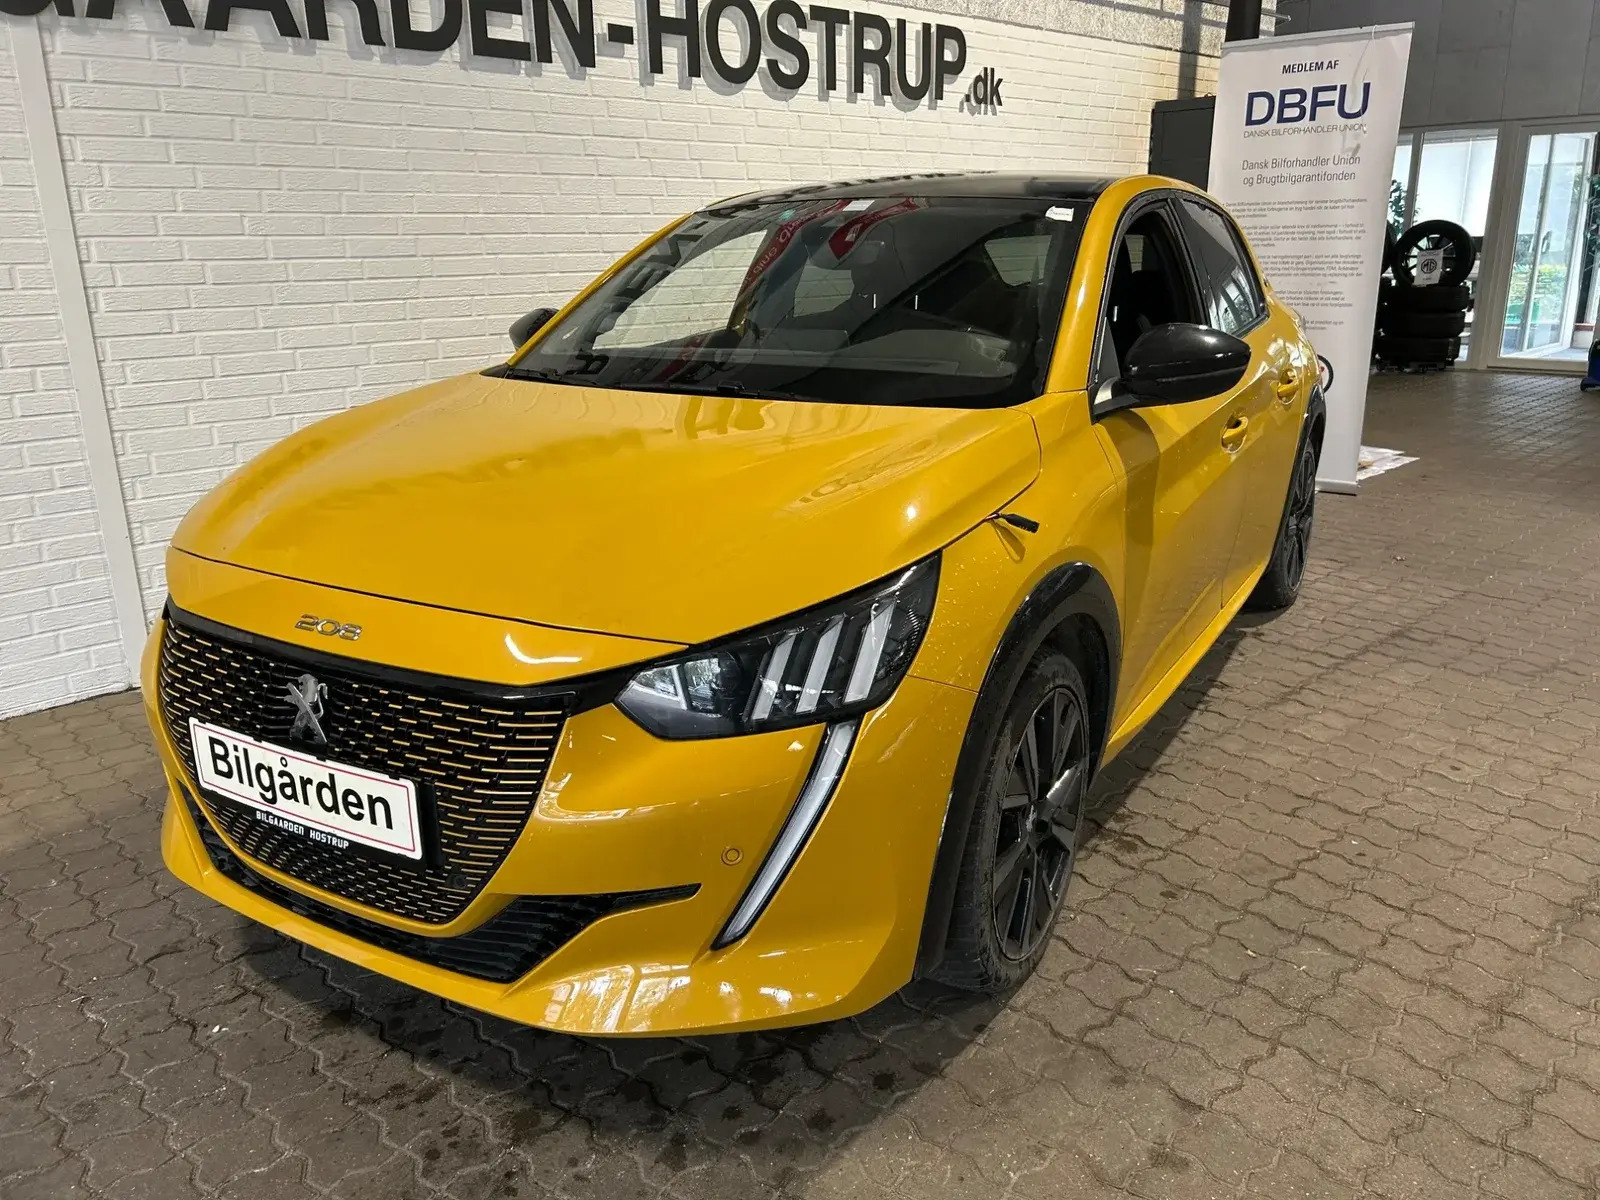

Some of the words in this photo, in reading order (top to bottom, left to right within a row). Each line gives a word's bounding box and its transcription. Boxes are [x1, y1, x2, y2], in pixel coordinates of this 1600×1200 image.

[1281, 61, 1324, 74] MEDLEM
[1326, 59, 1340, 70] AF
[1244, 82, 1371, 127] DBFU
[1243, 130, 1271, 139] DANSK
[1271, 124, 1338, 137] BILFORHANDLER
[1338, 123, 1367, 133] UNION
[1241, 158, 1269, 171] Dansk
[1270, 157, 1330, 170] Bilforhandler
[1332, 154, 1361, 166] Union
[1242, 176, 1254, 187] og
[1256, 170, 1356, 186] Brugtbilgarantifonden
[294, 613, 363, 641] 208
[208, 735, 394, 831] Bilgården
[255, 810, 305, 836] BILGAARDEN
[309, 829, 350, 850] HOSTRUP
